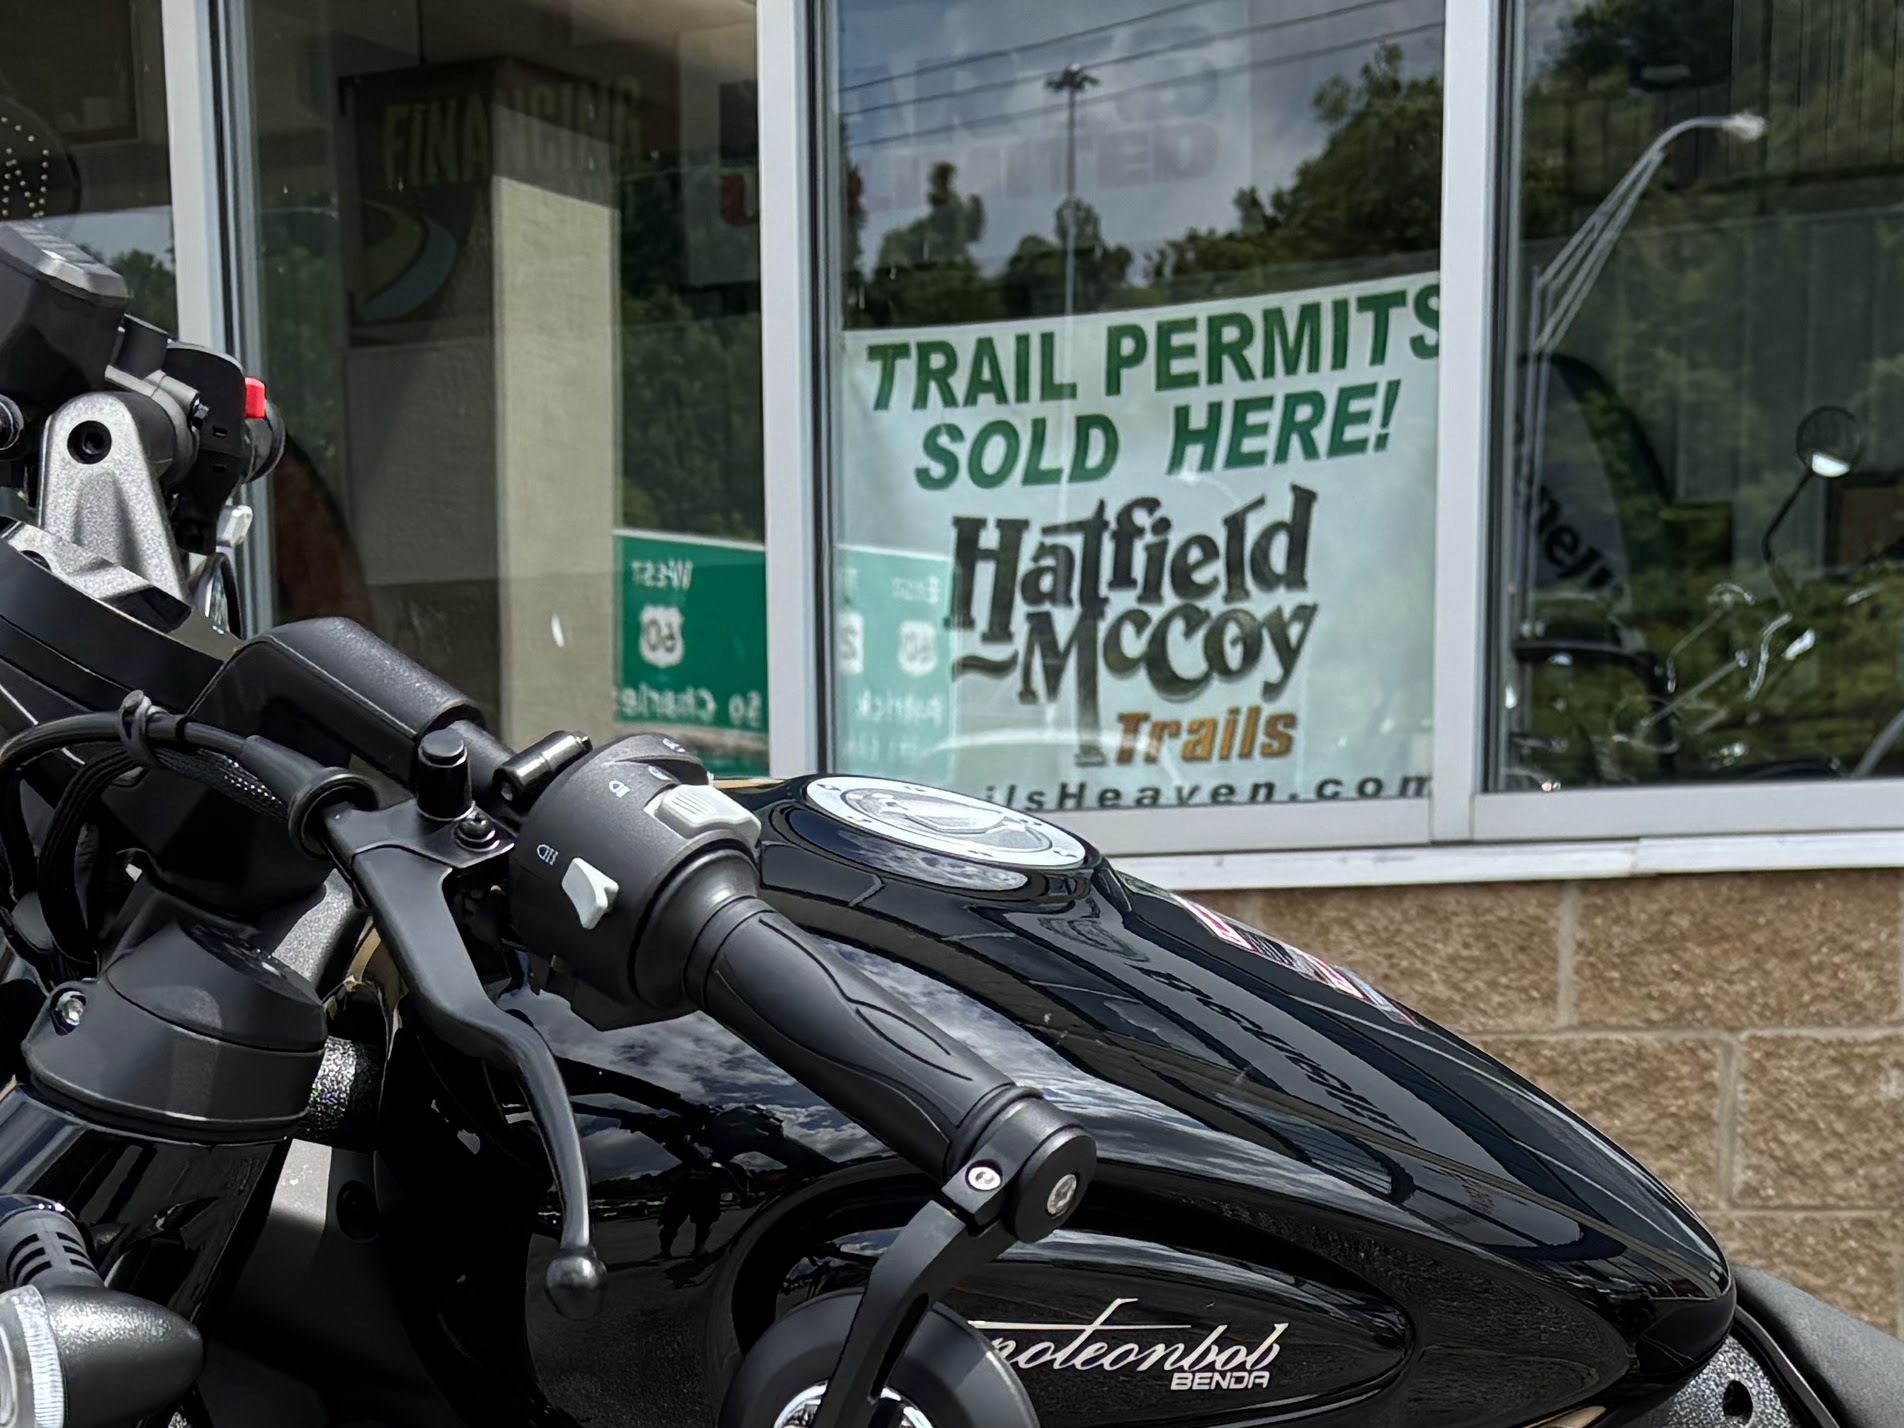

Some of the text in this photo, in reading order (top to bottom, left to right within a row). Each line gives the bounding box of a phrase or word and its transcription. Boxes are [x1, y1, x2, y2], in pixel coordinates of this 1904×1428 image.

[867, 282, 1441, 411] TRAIL PERMITS
[913, 378, 1402, 491] SOLD HERE!
[945, 484, 1318, 644] Hatfield
[1115, 705, 1298, 766] Trails
[982, 772, 1434, 812] ilsHeaven.com
[1170, 1371, 1270, 1391] BENDA
